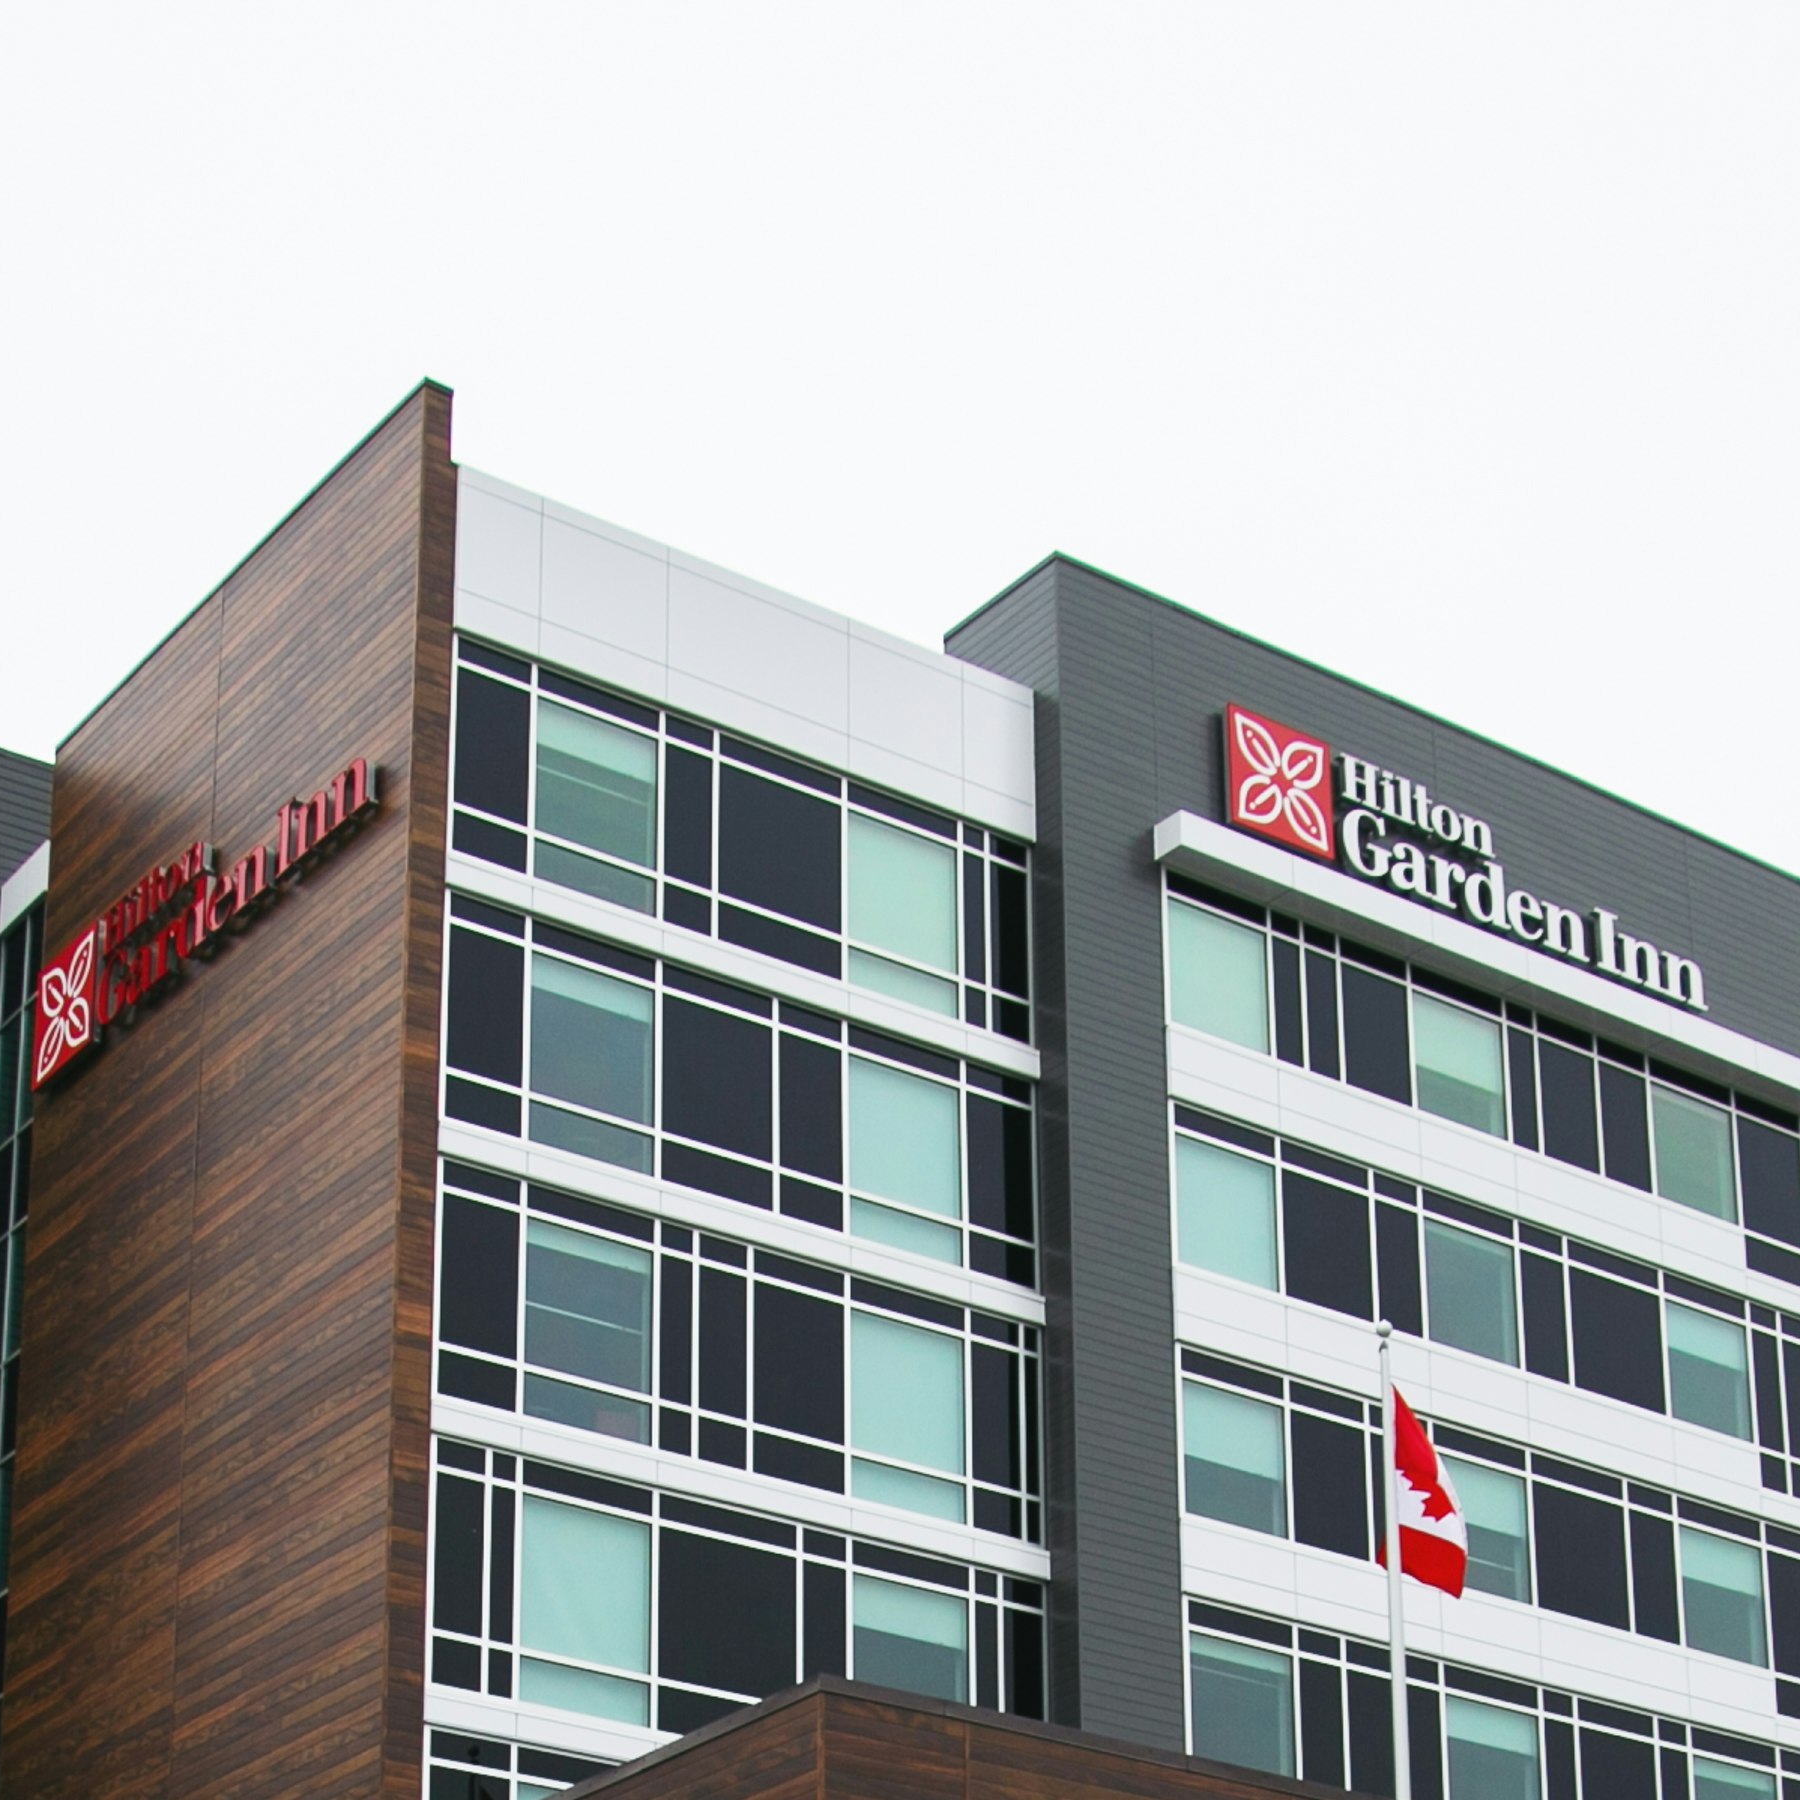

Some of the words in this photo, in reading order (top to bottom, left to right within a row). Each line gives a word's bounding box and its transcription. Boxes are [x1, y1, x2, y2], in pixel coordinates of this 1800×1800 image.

[1340, 752, 1497, 859] Hilton
[97, 844, 278, 1026] Garden
[276, 757, 380, 880] Inn
[101, 841, 218, 958] Hilton
[1342, 808, 1592, 964] Garden
[1592, 906, 1709, 1012] Inn
